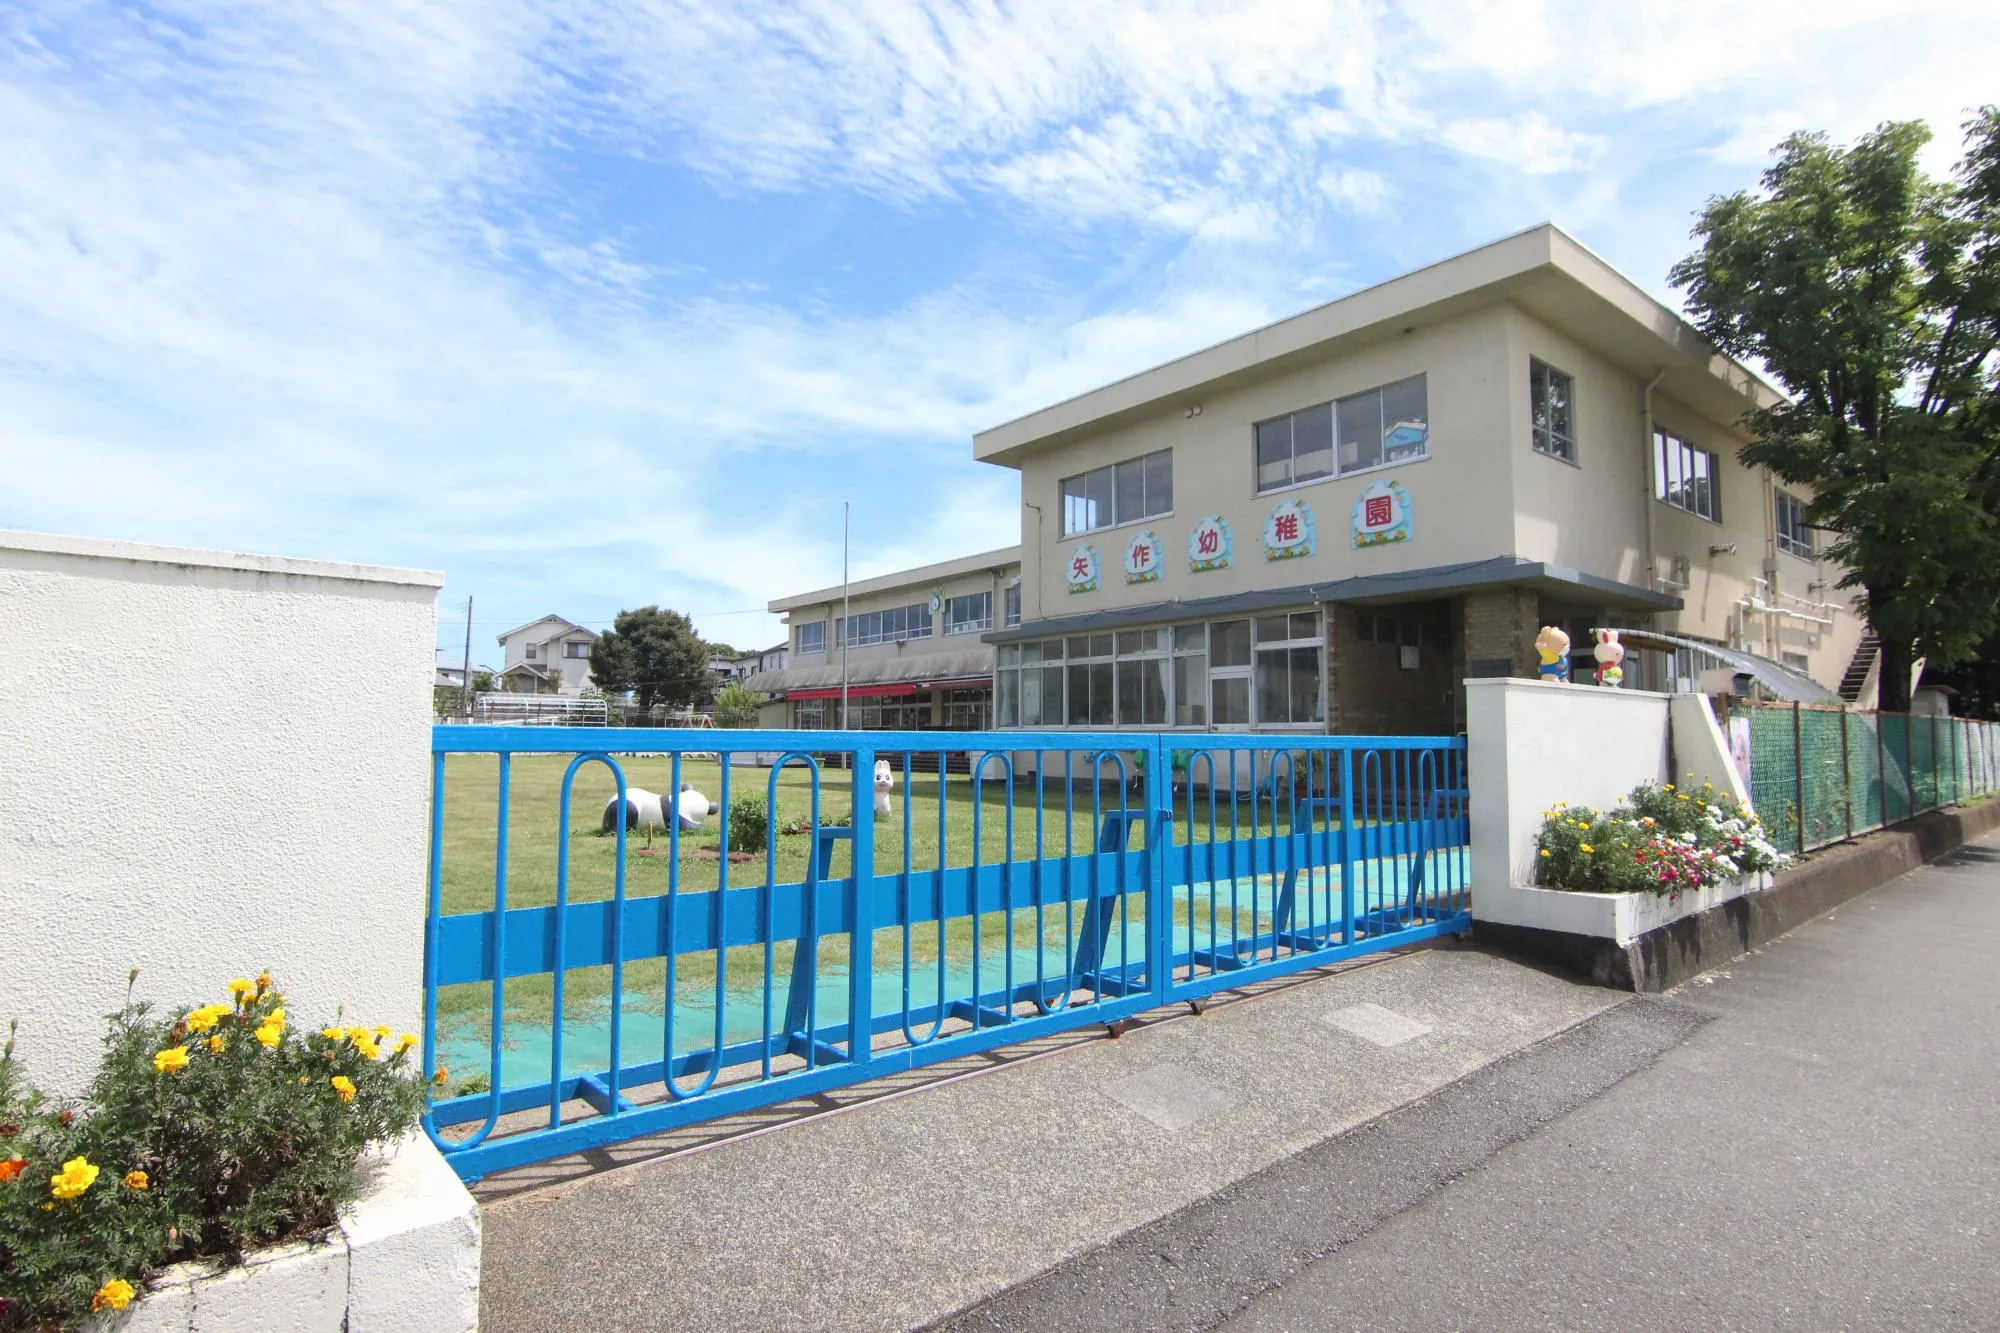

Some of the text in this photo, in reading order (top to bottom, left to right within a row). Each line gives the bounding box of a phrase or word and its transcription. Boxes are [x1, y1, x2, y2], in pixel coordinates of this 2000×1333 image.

[1073, 495, 1392, 580] 矢作幼稚園
